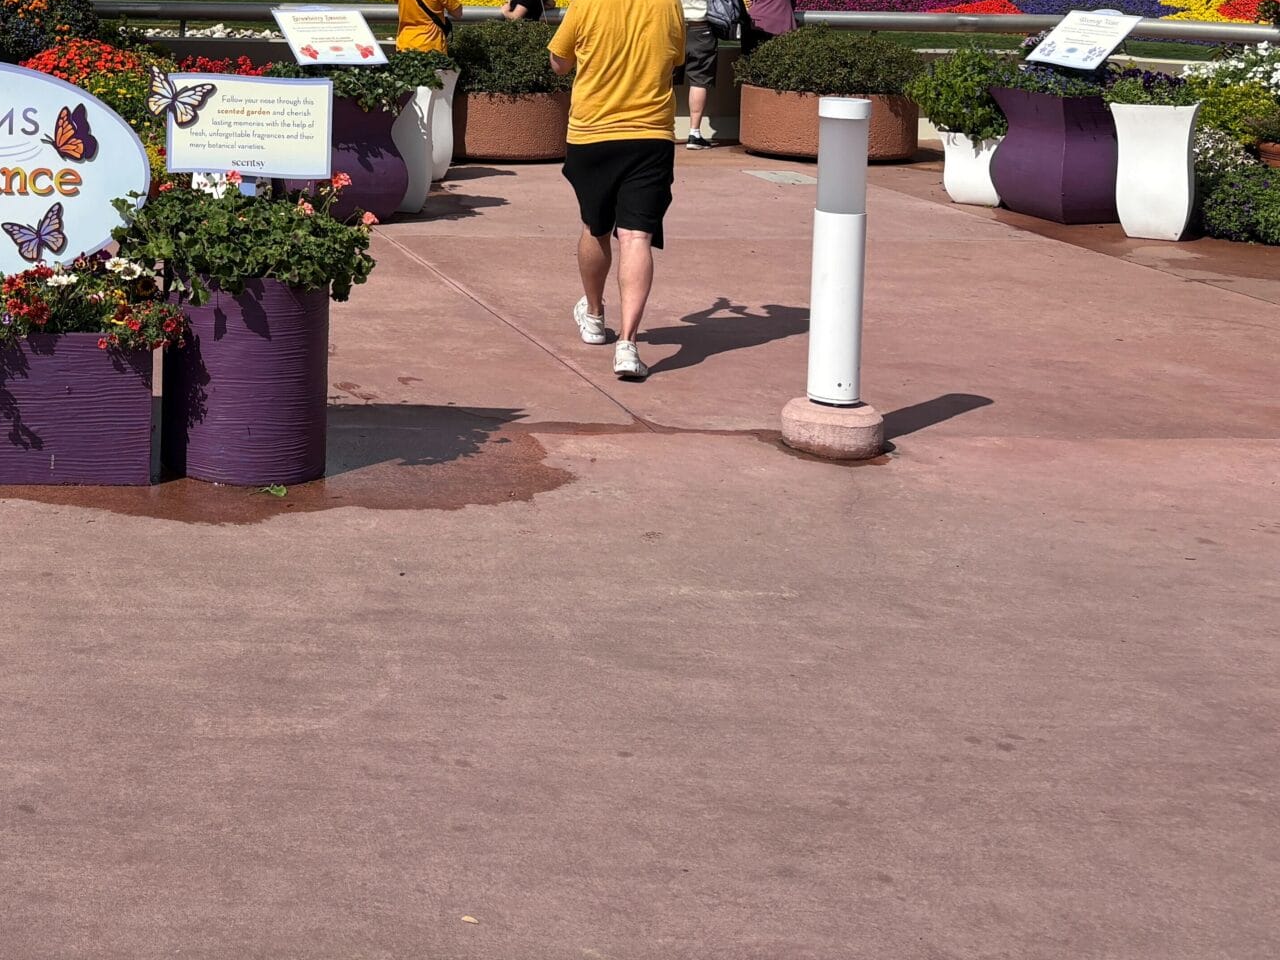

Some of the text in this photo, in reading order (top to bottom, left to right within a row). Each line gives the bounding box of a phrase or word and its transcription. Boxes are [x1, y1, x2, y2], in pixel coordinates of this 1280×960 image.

[221, 95, 244, 103] Follow
[276, 97, 302, 106] through
[302, 97, 315, 105] this
[217, 107, 311, 116] scented garden and cherish
[211, 118, 232, 128] lasting
[280, 120, 292, 128] the
[292, 120, 307, 130] help
[307, 120, 315, 129] of
[209, 129, 251, 139] unforgettable
[252, 130, 286, 140] fragrances
[286, 132, 299, 140] and
[299, 132, 315, 140] their
[207, 141, 237, 149] botanical
[231, 159, 265, 169] scentsy
